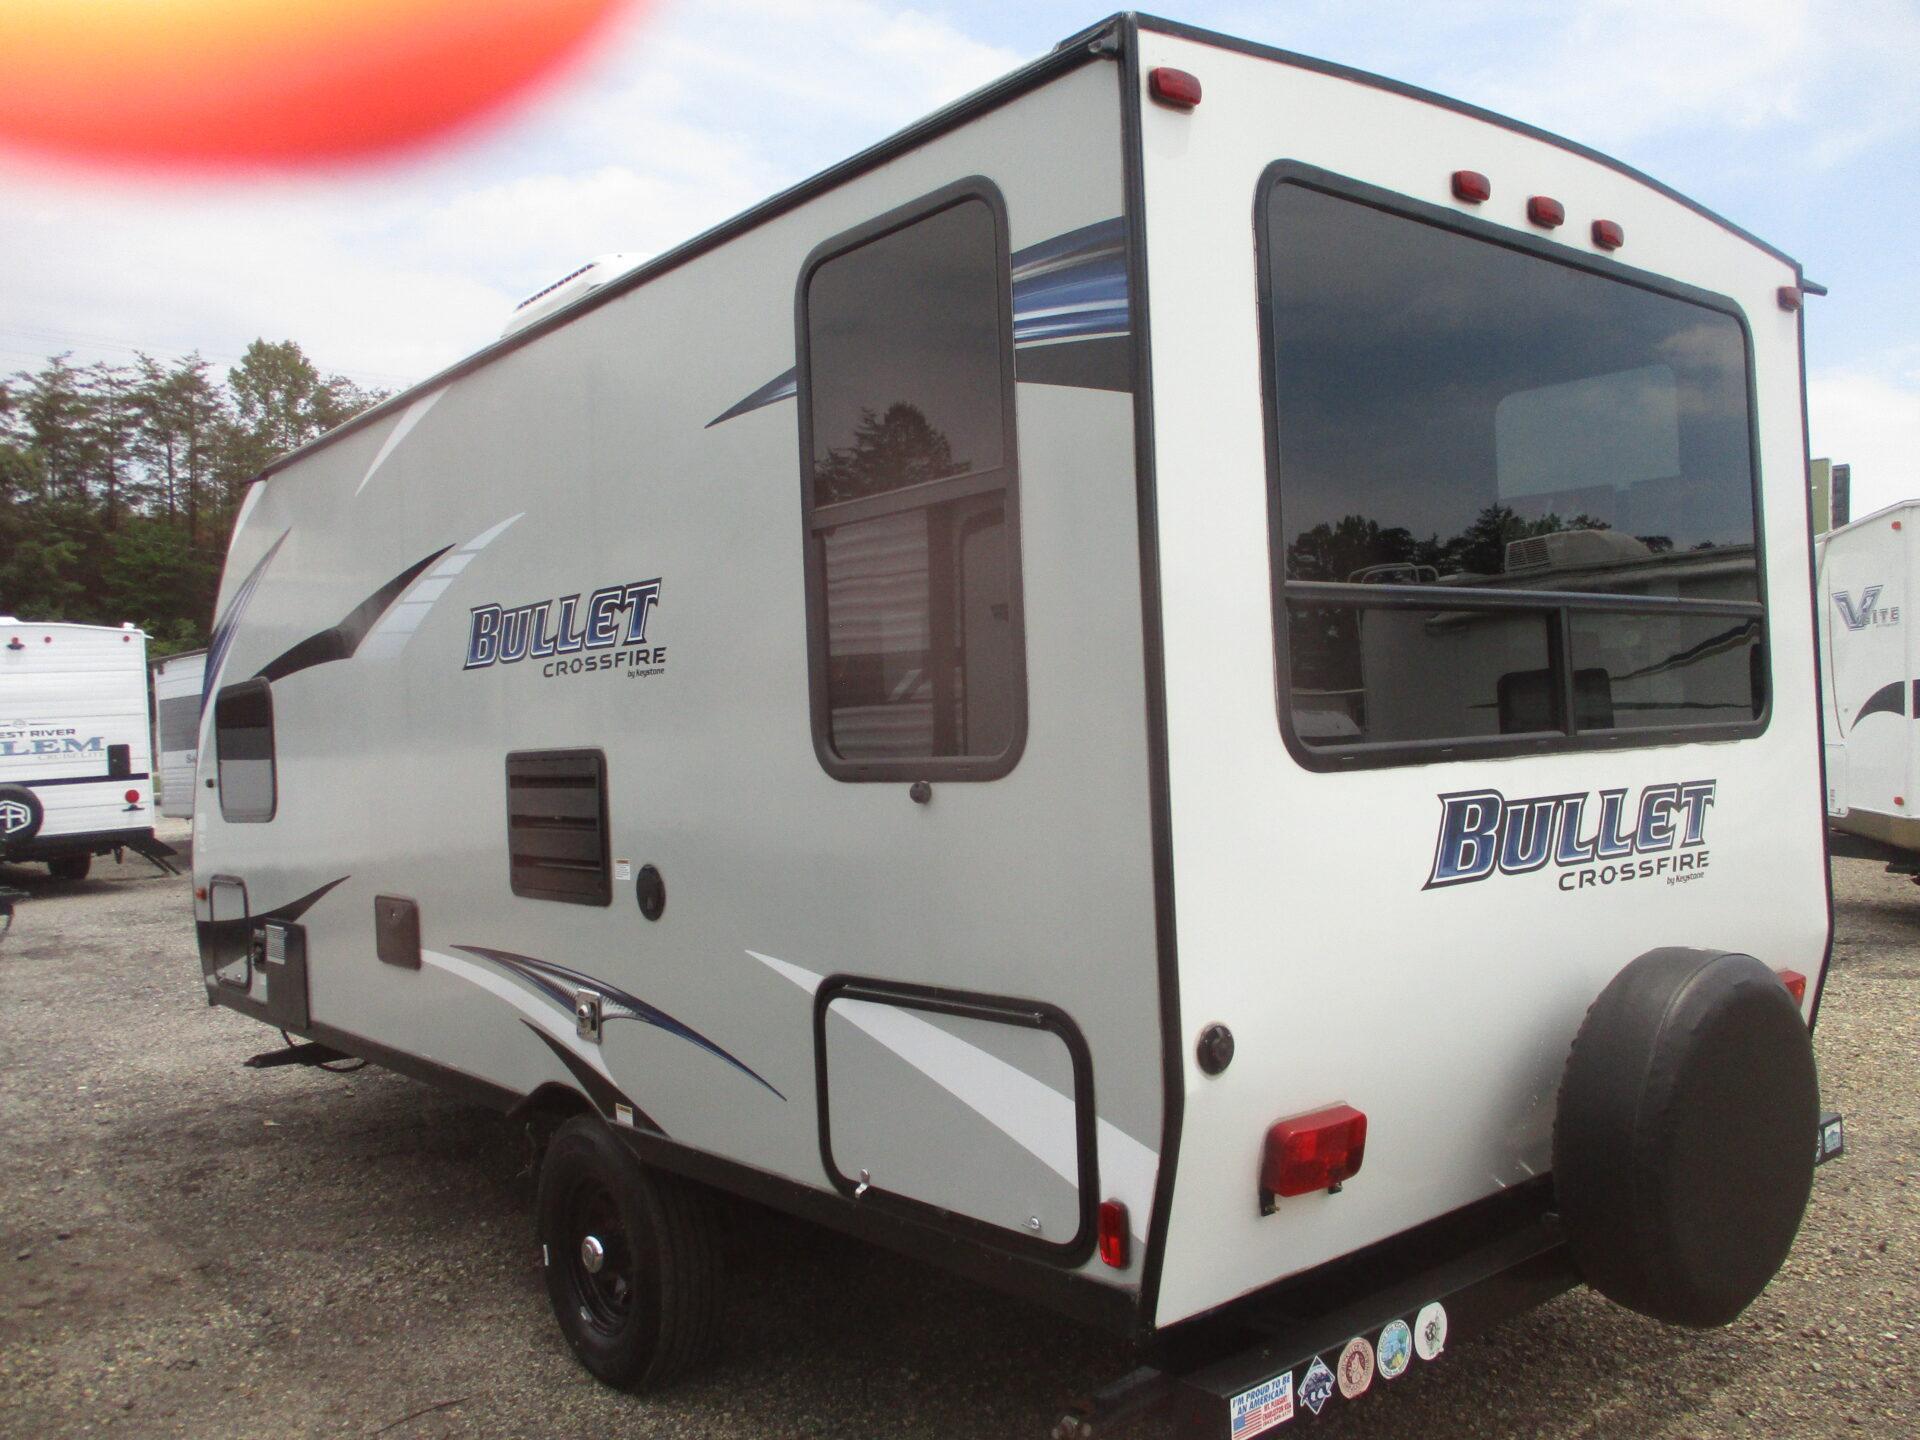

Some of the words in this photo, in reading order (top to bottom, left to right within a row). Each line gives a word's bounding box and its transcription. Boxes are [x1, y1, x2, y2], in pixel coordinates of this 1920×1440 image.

[462, 577, 663, 671] BULLET
[543, 647, 667, 678] CROSSFIRE
[30, 728, 76, 737] RIVER
[1421, 779, 1717, 891] BULLET
[1558, 851, 1710, 891] CROSSFIRE
[1667, 876, 1675, 886] by
[1233, 1397, 1244, 1408] I'M
[1246, 1385, 1270, 1402] PROUD
[1272, 1380, 1280, 1390] TO
[1282, 1375, 1290, 1385] BE
[1238, 1404, 1247, 1416] AN
[1249, 1385, 1287, 1410] AMERICAN!
